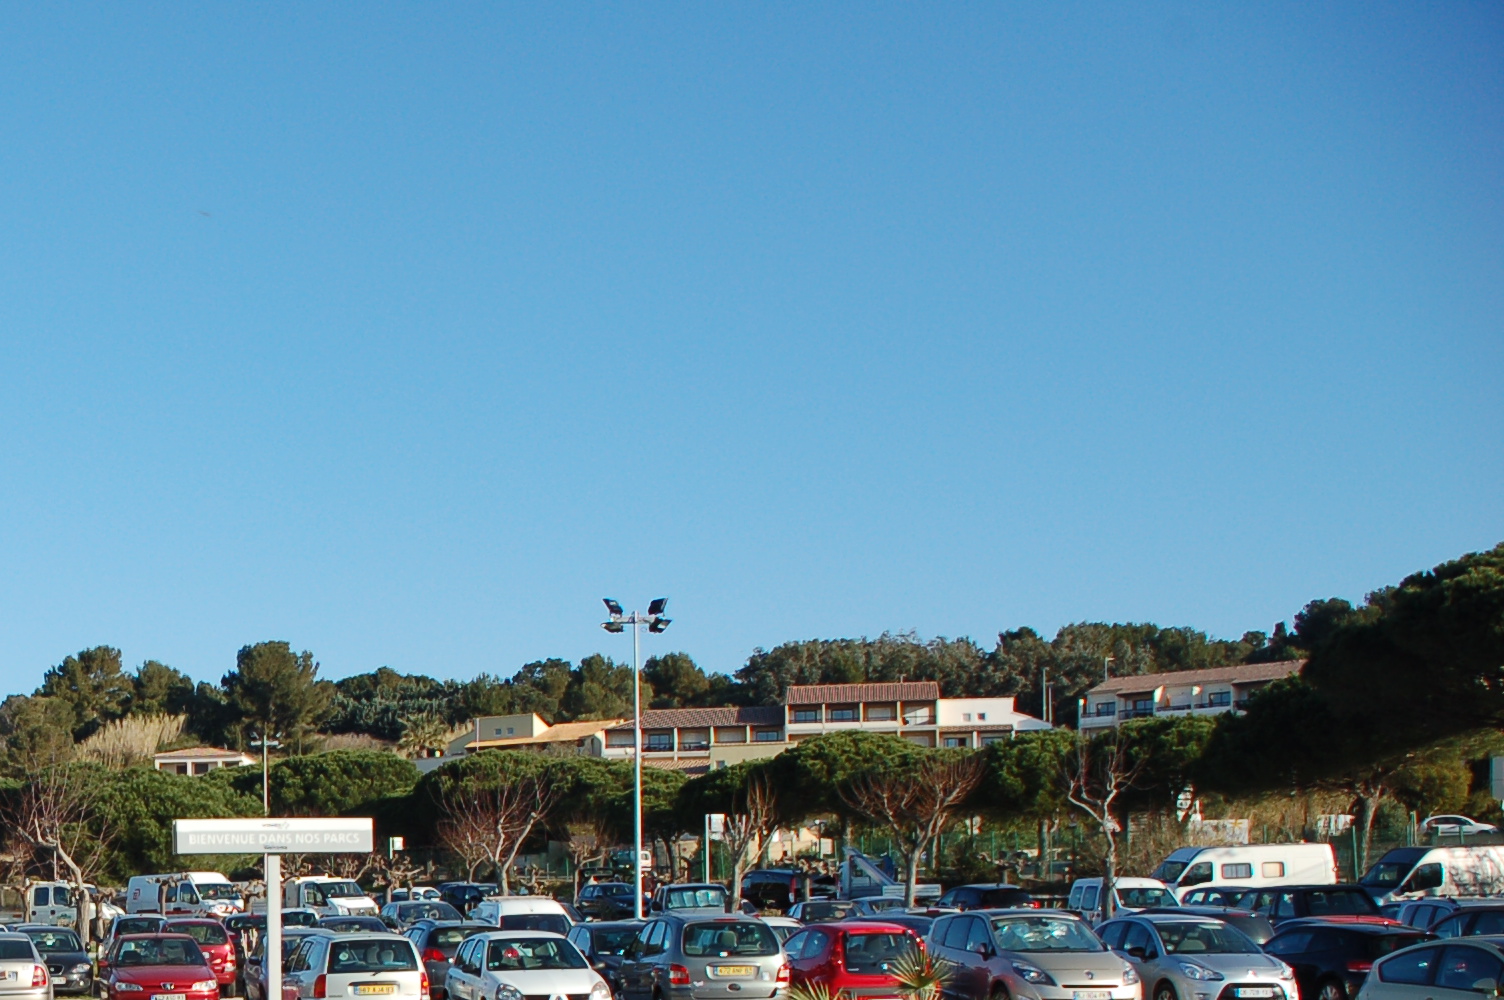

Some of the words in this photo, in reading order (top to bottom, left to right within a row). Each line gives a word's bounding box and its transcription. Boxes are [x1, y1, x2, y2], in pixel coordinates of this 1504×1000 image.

[188, 833, 256, 845] BIENVENUE
[259, 833, 292, 844] DANS
[295, 832, 320, 844] NOS
[323, 832, 360, 844] PARCS
